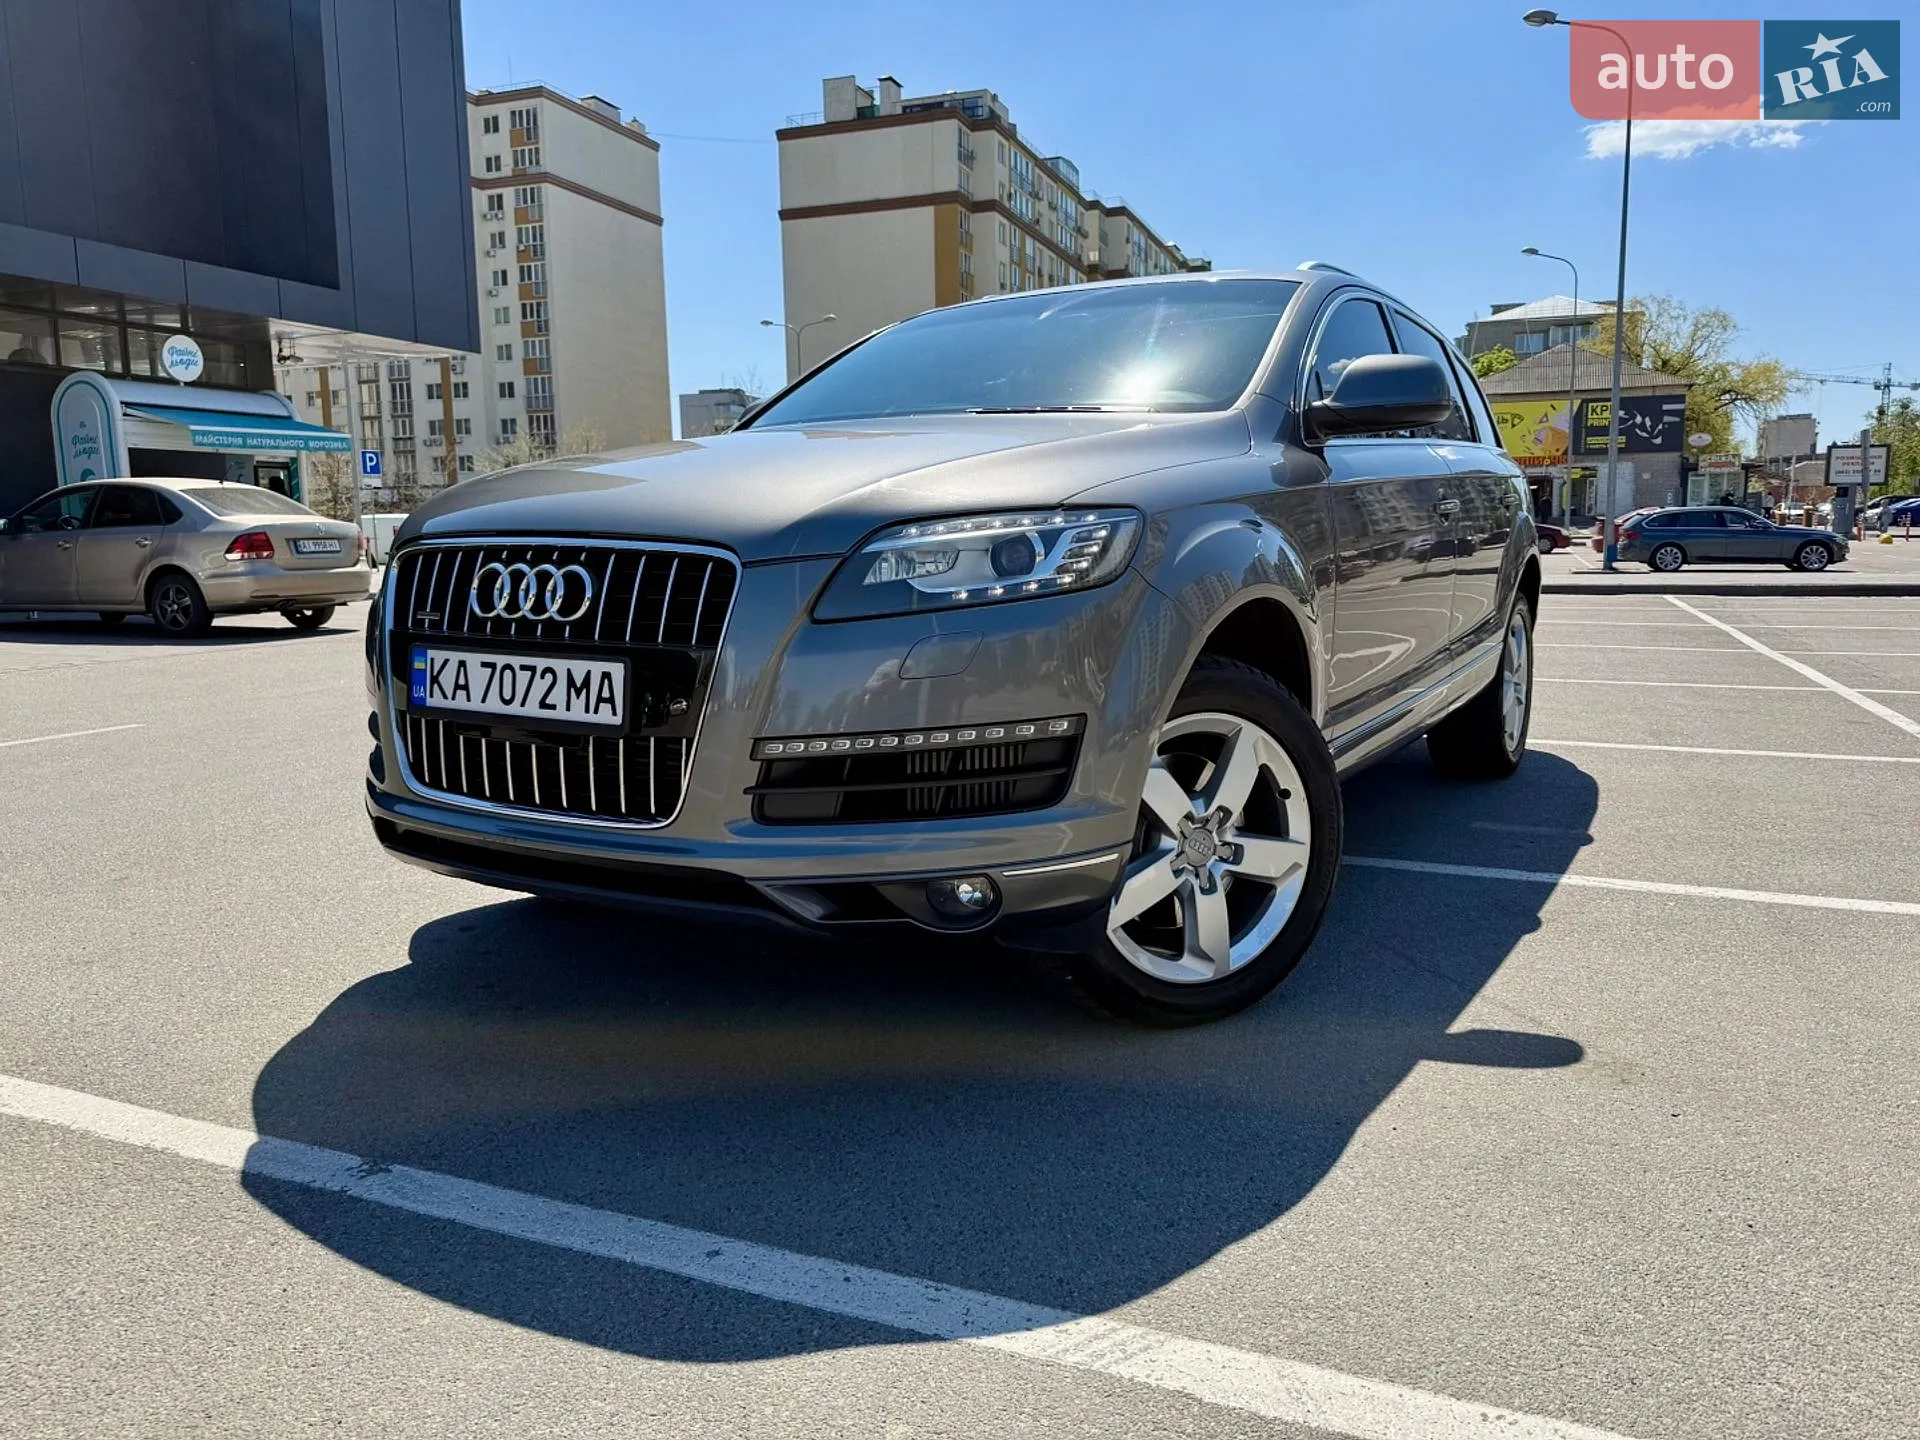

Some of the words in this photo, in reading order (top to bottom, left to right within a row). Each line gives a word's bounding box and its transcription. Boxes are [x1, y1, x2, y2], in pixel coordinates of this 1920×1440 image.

[366, 453, 376, 472] P
[413, 686, 425, 698] UA
[430, 657, 471, 702] KA
[480, 661, 557, 710] 7072
[566, 668, 617, 716] MA
